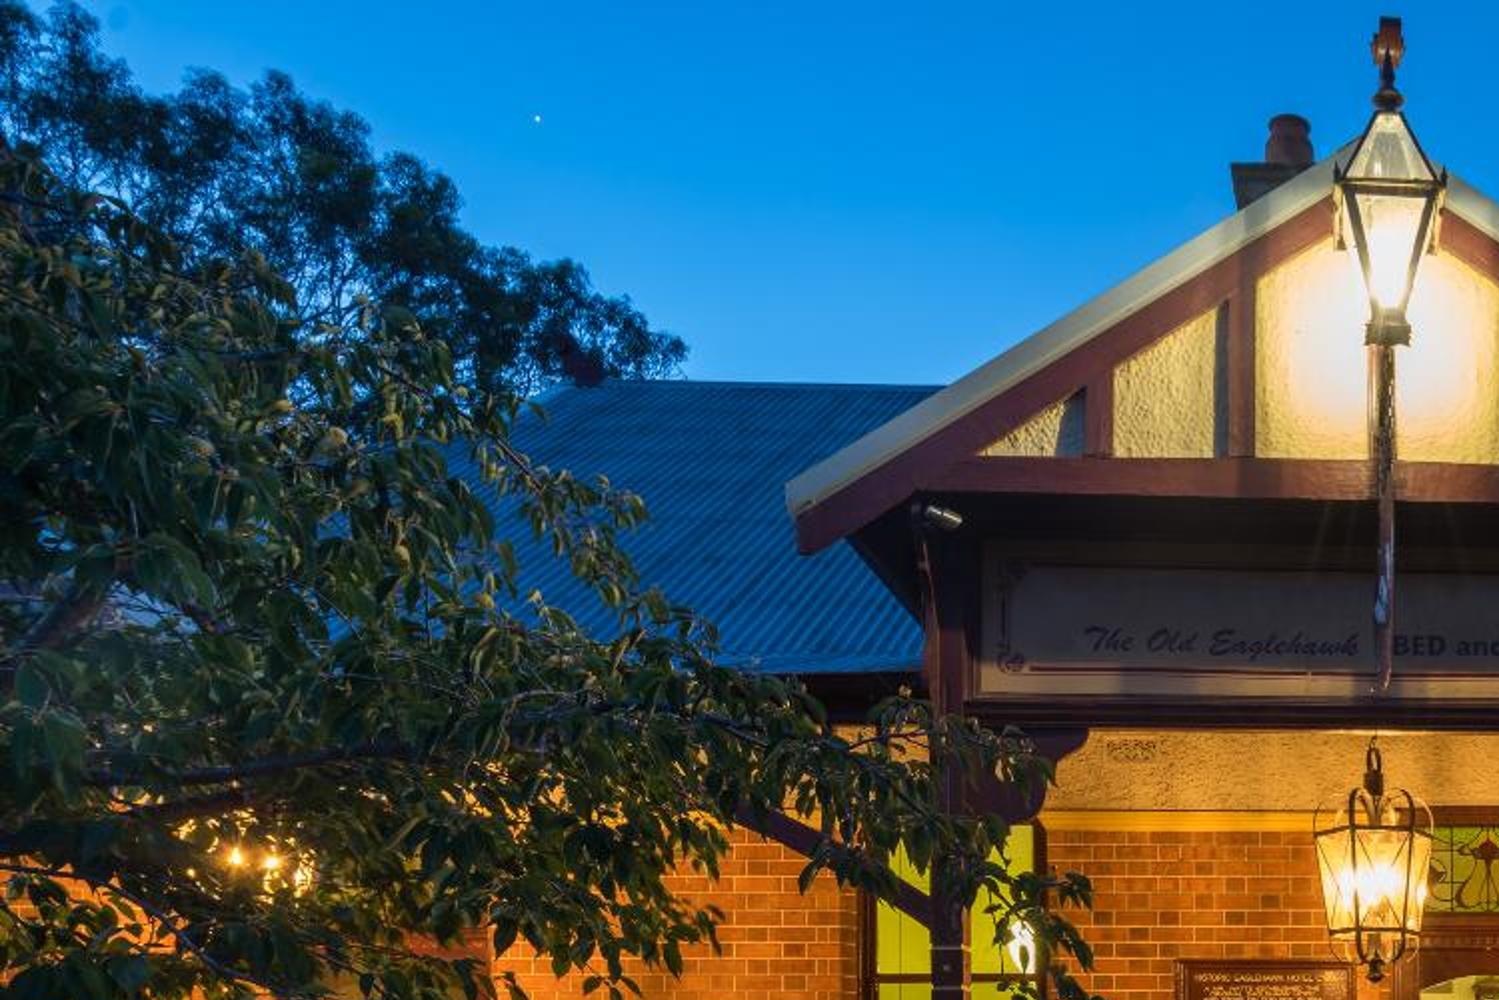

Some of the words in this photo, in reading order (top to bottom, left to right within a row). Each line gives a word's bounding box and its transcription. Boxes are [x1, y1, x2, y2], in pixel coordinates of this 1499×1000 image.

[1084, 626, 1132, 653] The
[1147, 627, 1198, 654] Old
[1209, 628, 1360, 661] Eaglehawk
[1392, 635, 1446, 657] BED
